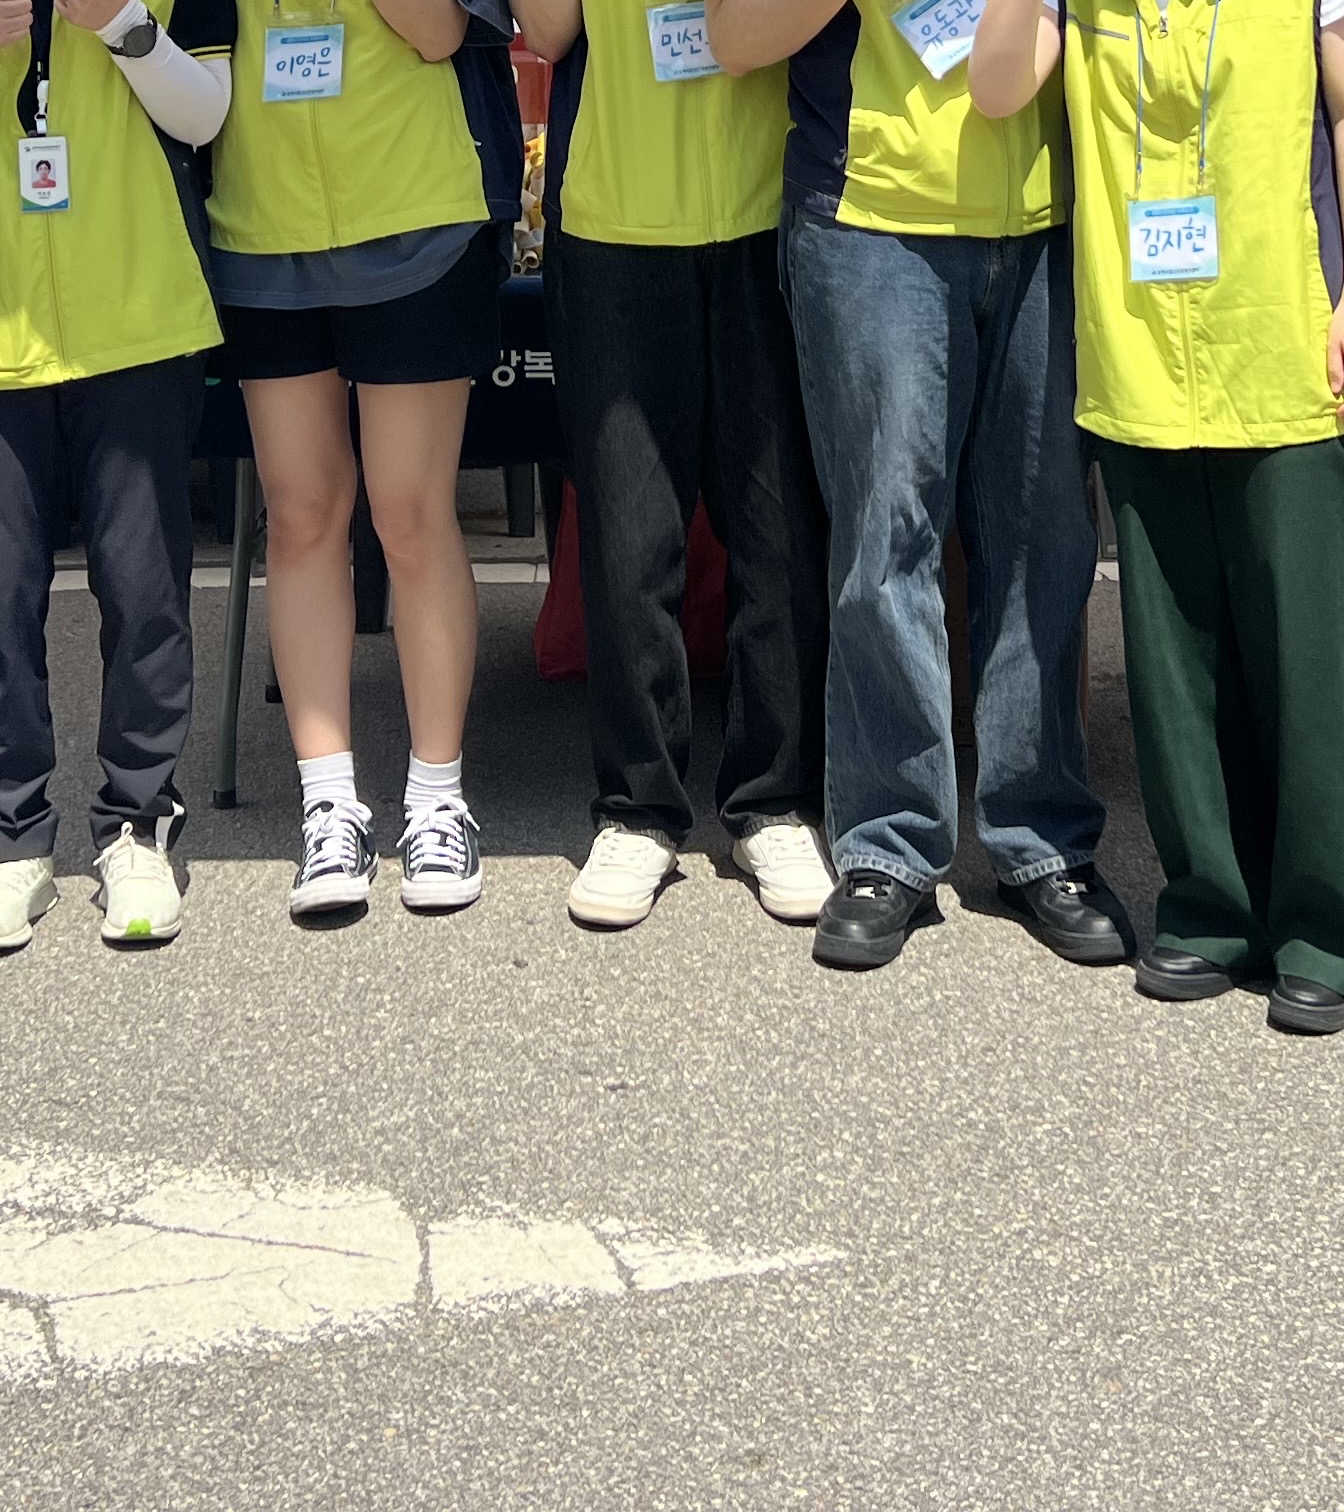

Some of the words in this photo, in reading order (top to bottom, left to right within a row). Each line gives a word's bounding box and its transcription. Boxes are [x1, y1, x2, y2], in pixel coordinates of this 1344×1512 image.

[661, 27, 709, 57] 민선
[276, 47, 332, 77] 이영은
[1139, 217, 1207, 257] 김지현
